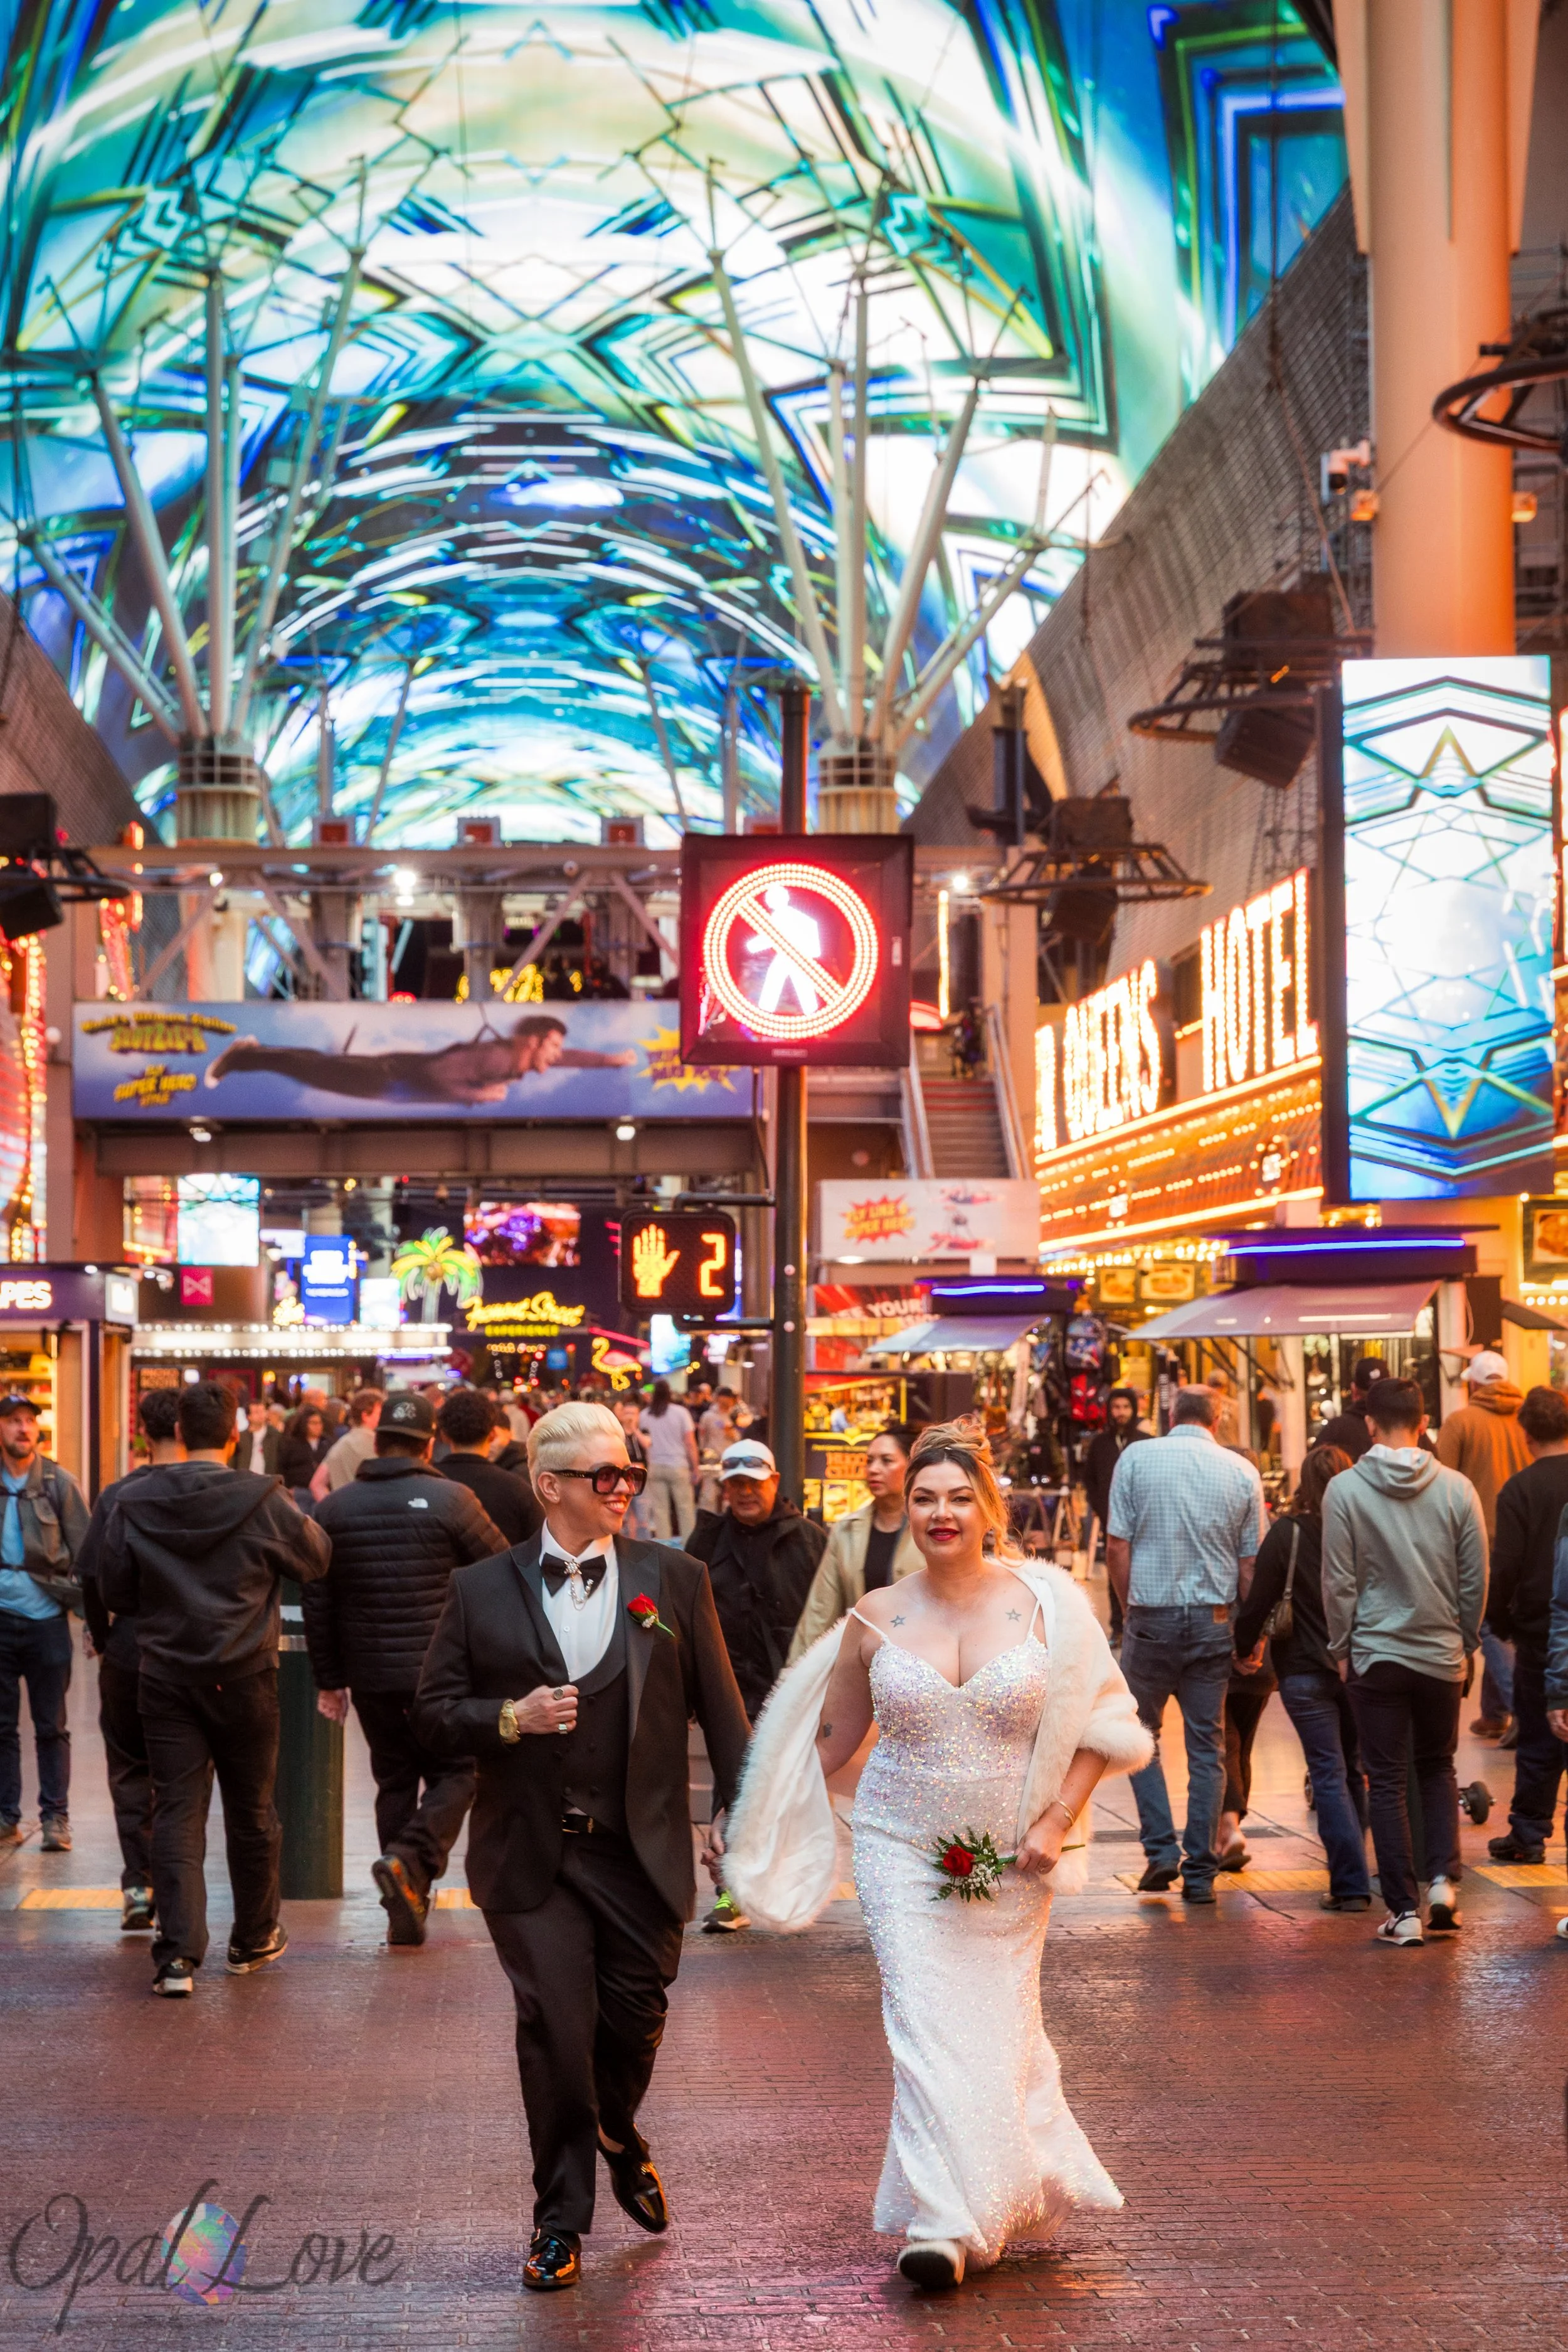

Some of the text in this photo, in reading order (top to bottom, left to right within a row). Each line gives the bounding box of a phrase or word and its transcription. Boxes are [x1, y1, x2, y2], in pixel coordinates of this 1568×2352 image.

[1200, 866, 1319, 1092] HOTEL
[0, 1280, 51, 1309] PES
[699, 1232, 726, 1296] 2
